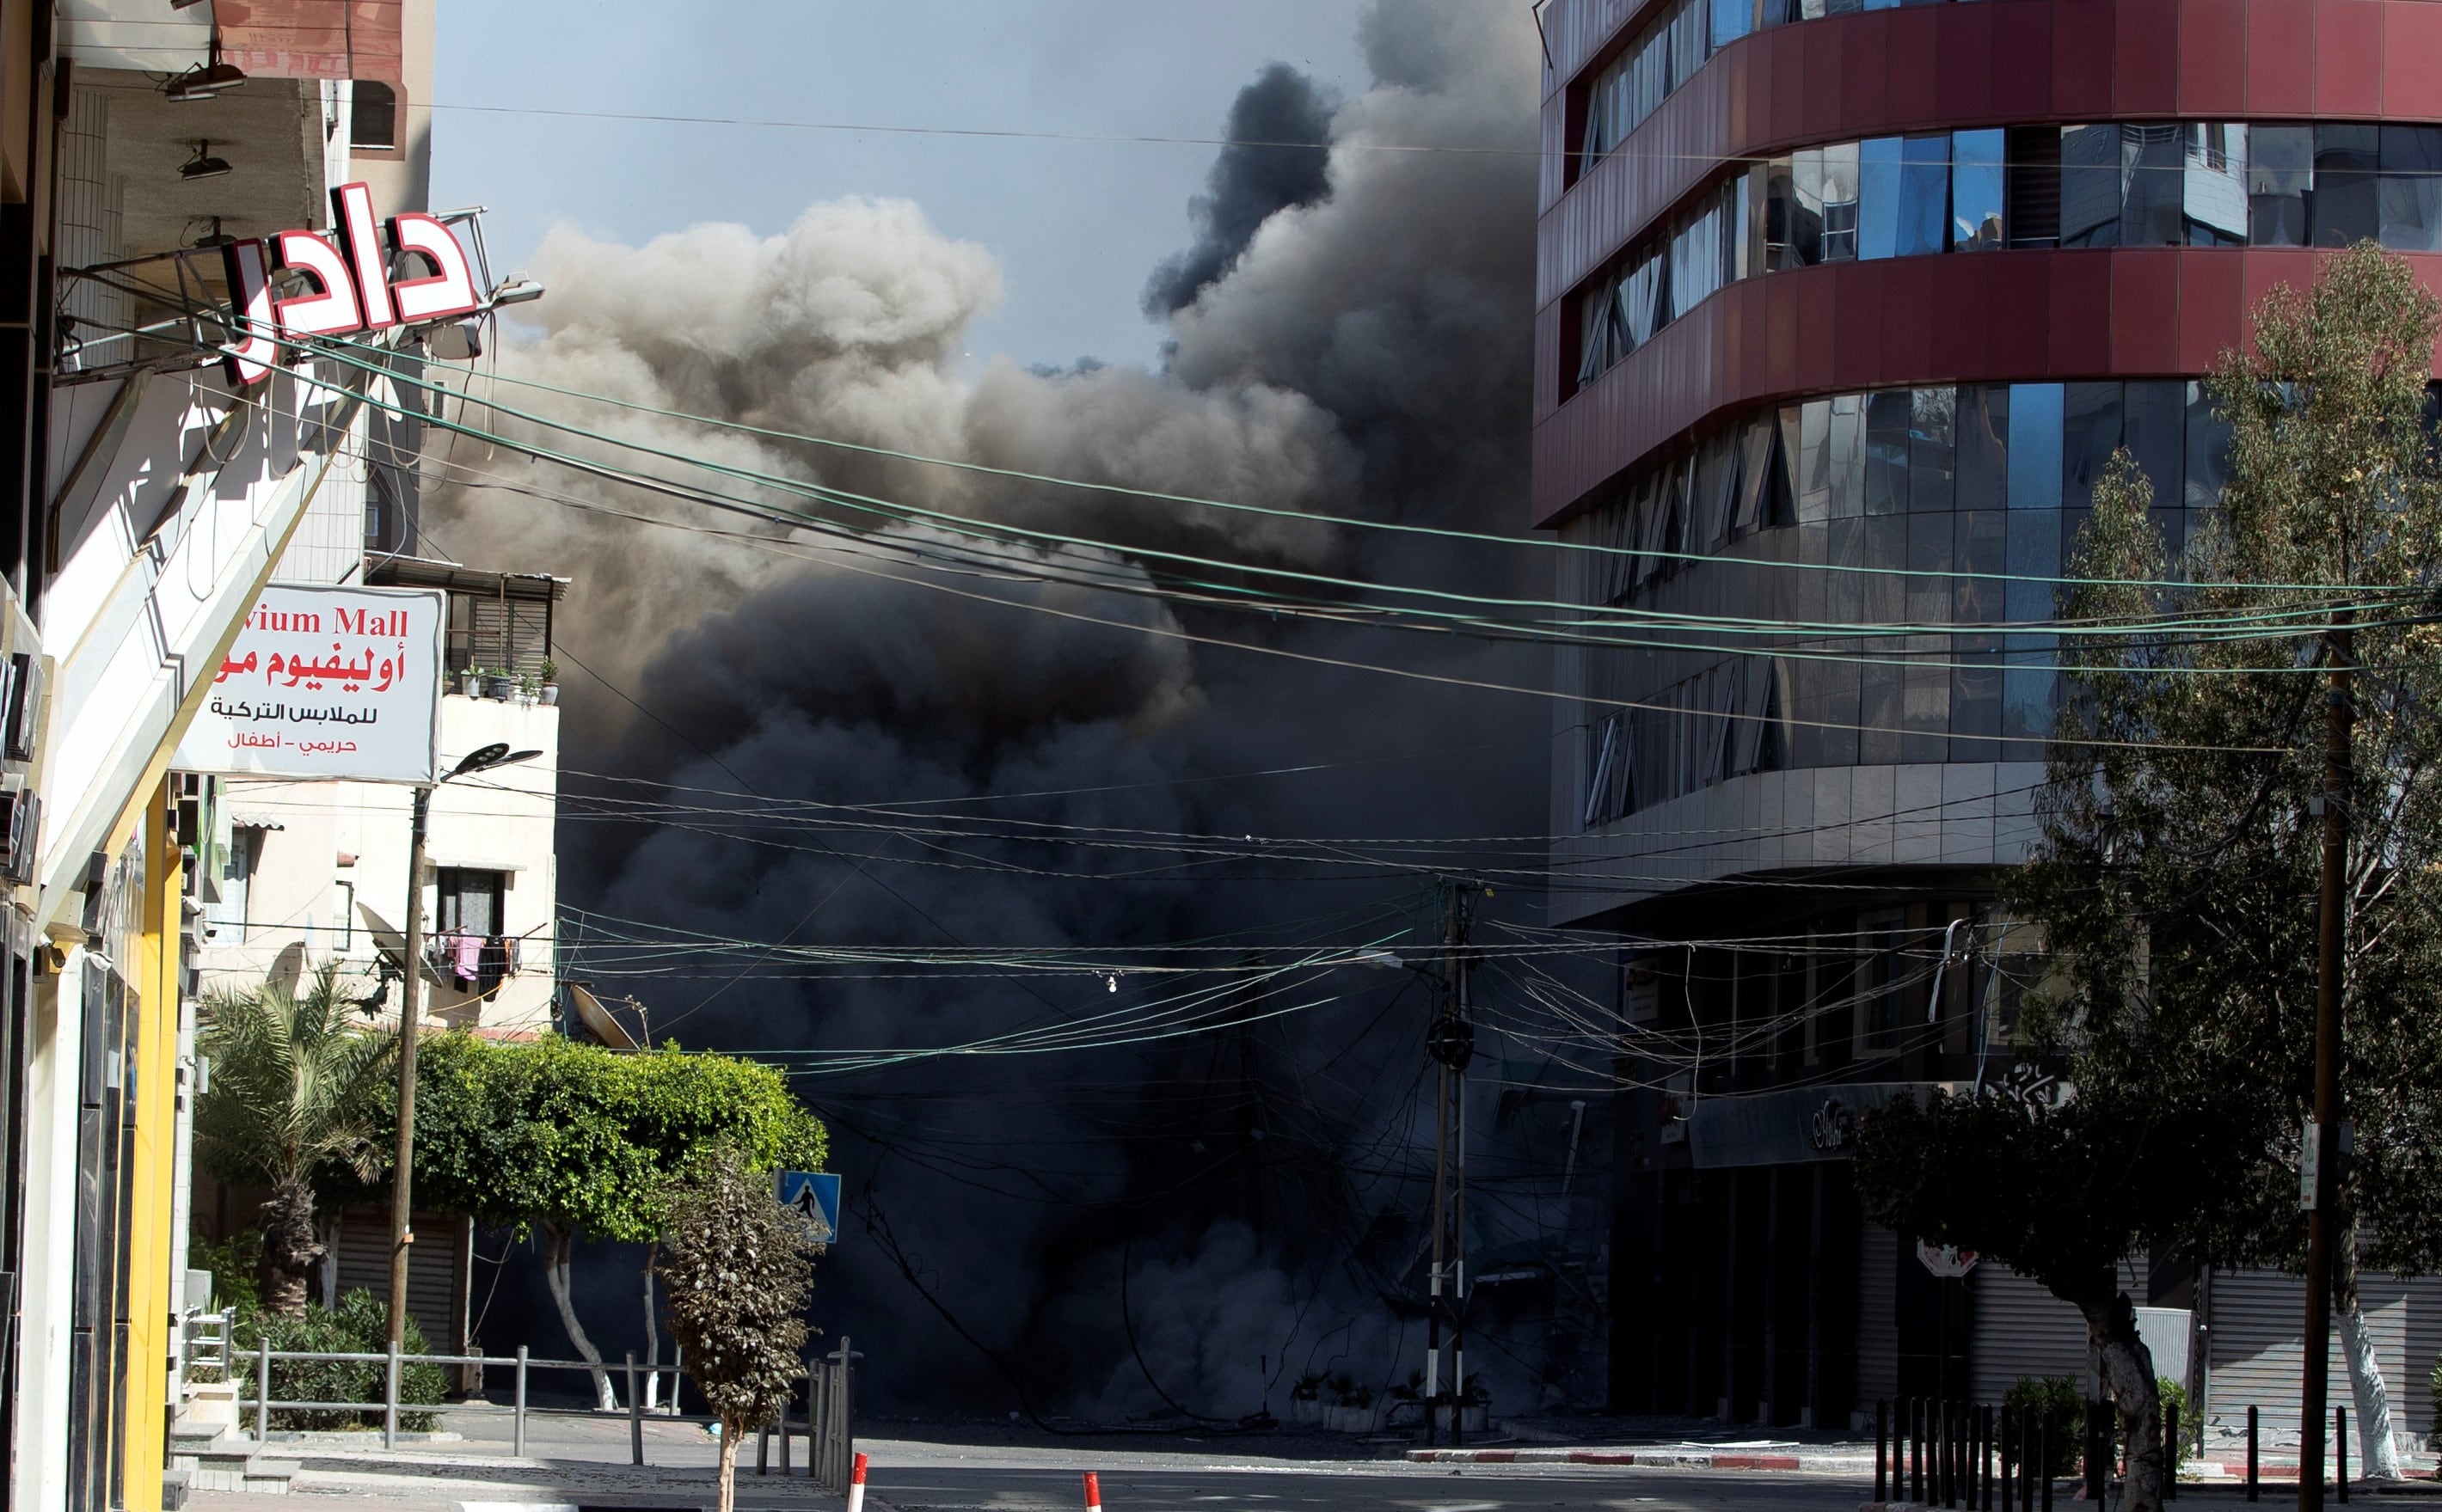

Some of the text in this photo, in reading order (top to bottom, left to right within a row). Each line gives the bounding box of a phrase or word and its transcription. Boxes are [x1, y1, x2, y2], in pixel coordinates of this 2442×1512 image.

[244, 603, 408, 638] vium Mall
[212, 640, 406, 693] أوليفيوم مو
[210, 696, 378, 725] للملابس التركية
[227, 731, 281, 750] أطفال
[298, 738, 358, 756] حريمي
